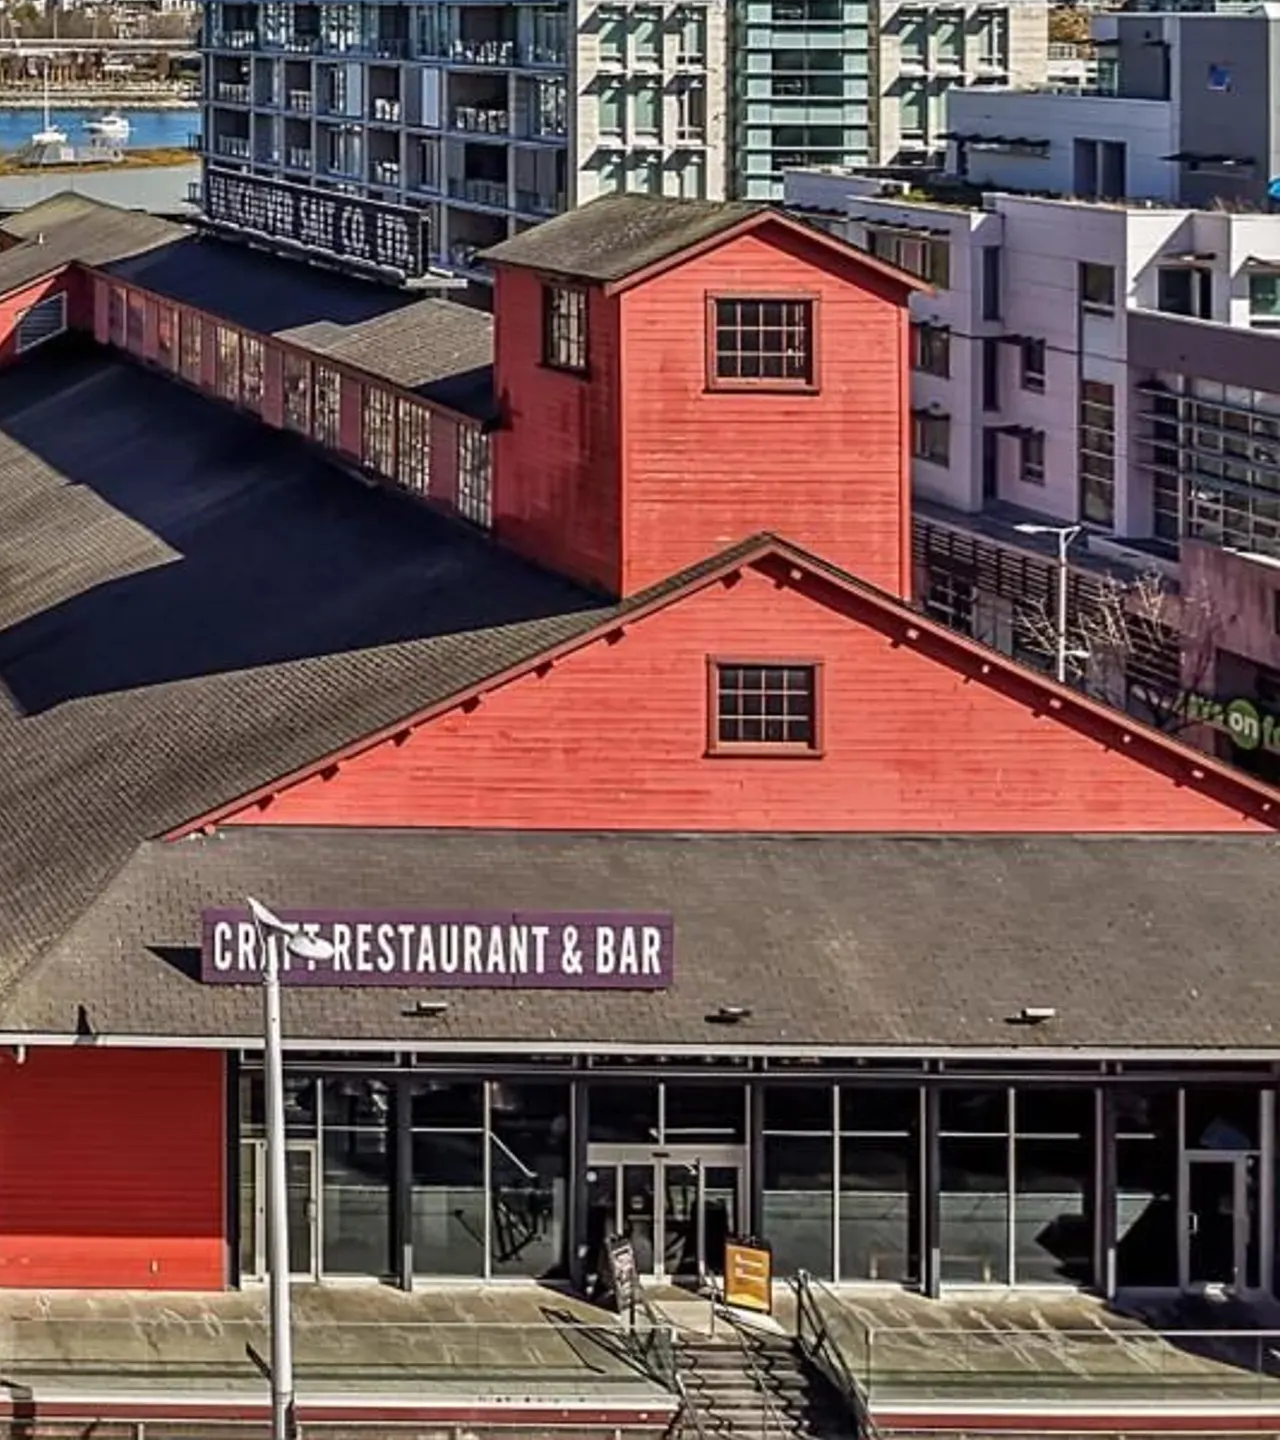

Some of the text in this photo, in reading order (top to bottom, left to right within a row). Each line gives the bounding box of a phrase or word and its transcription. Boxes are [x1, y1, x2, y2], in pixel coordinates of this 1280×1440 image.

[333, 923, 550, 973] RESTAURANT
[560, 925, 584, 975] &
[595, 926, 662, 975] BAR
